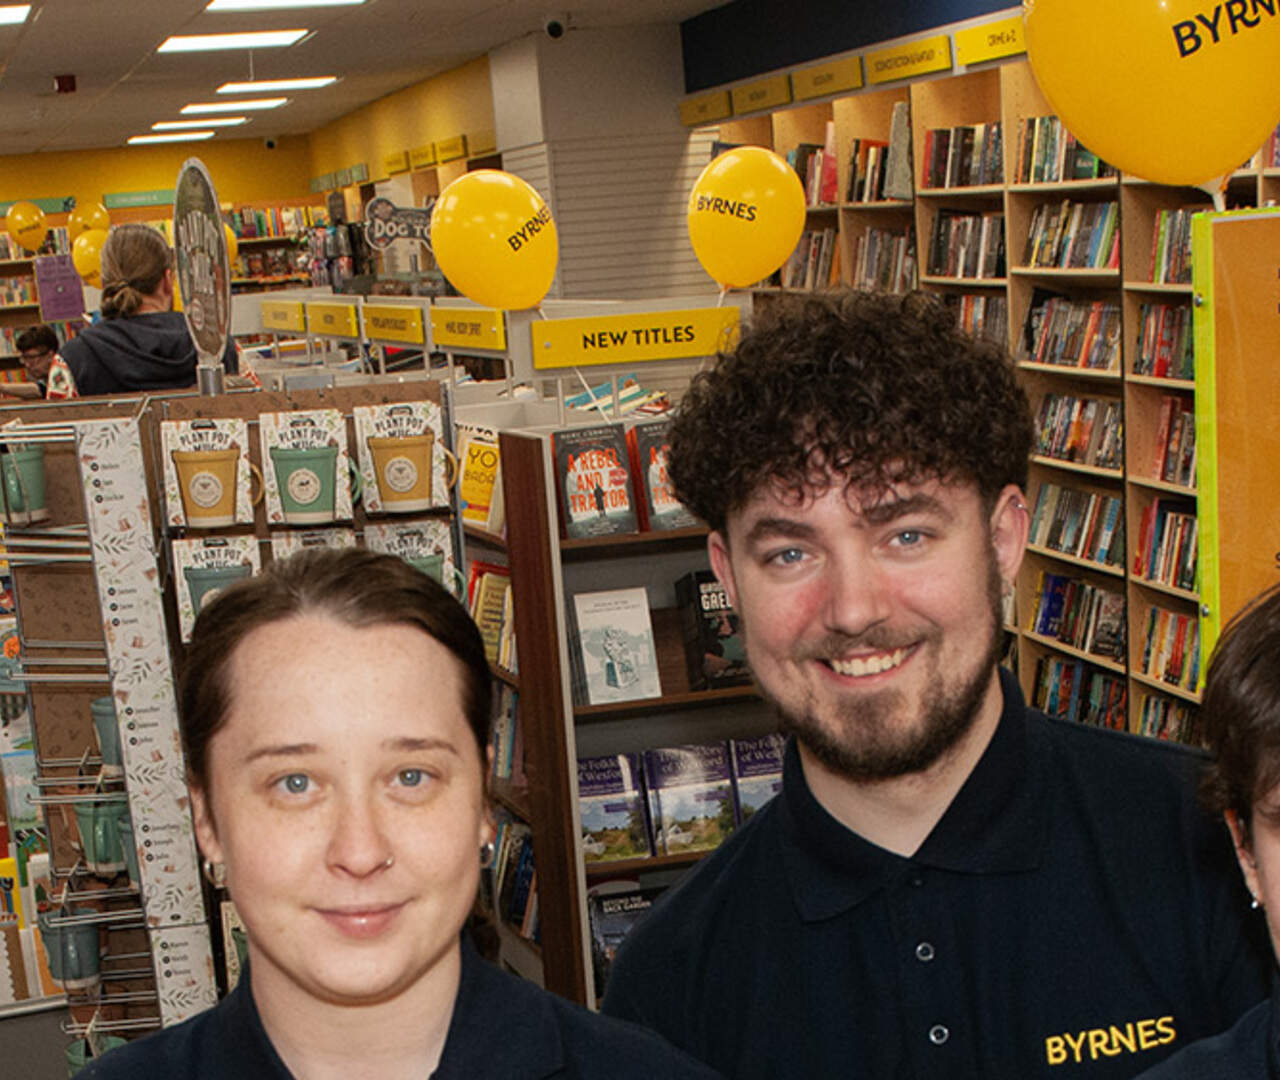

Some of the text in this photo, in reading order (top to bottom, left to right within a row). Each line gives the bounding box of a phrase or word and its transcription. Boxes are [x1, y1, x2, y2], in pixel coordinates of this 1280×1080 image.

[696, 193, 758, 222] BYRNES
[373, 218, 409, 238] DOG
[582, 325, 695, 350] NEW TITLES
[374, 416, 424, 433] PLANT POT
[180, 431, 230, 446] PLANT POT
[278, 427, 328, 442] PLANT POT
[580, 448, 621, 471] REBEL
[577, 472, 604, 491] AND
[192, 548, 242, 564] PLANT POT
[1044, 1016, 1176, 1065] BYRNES
